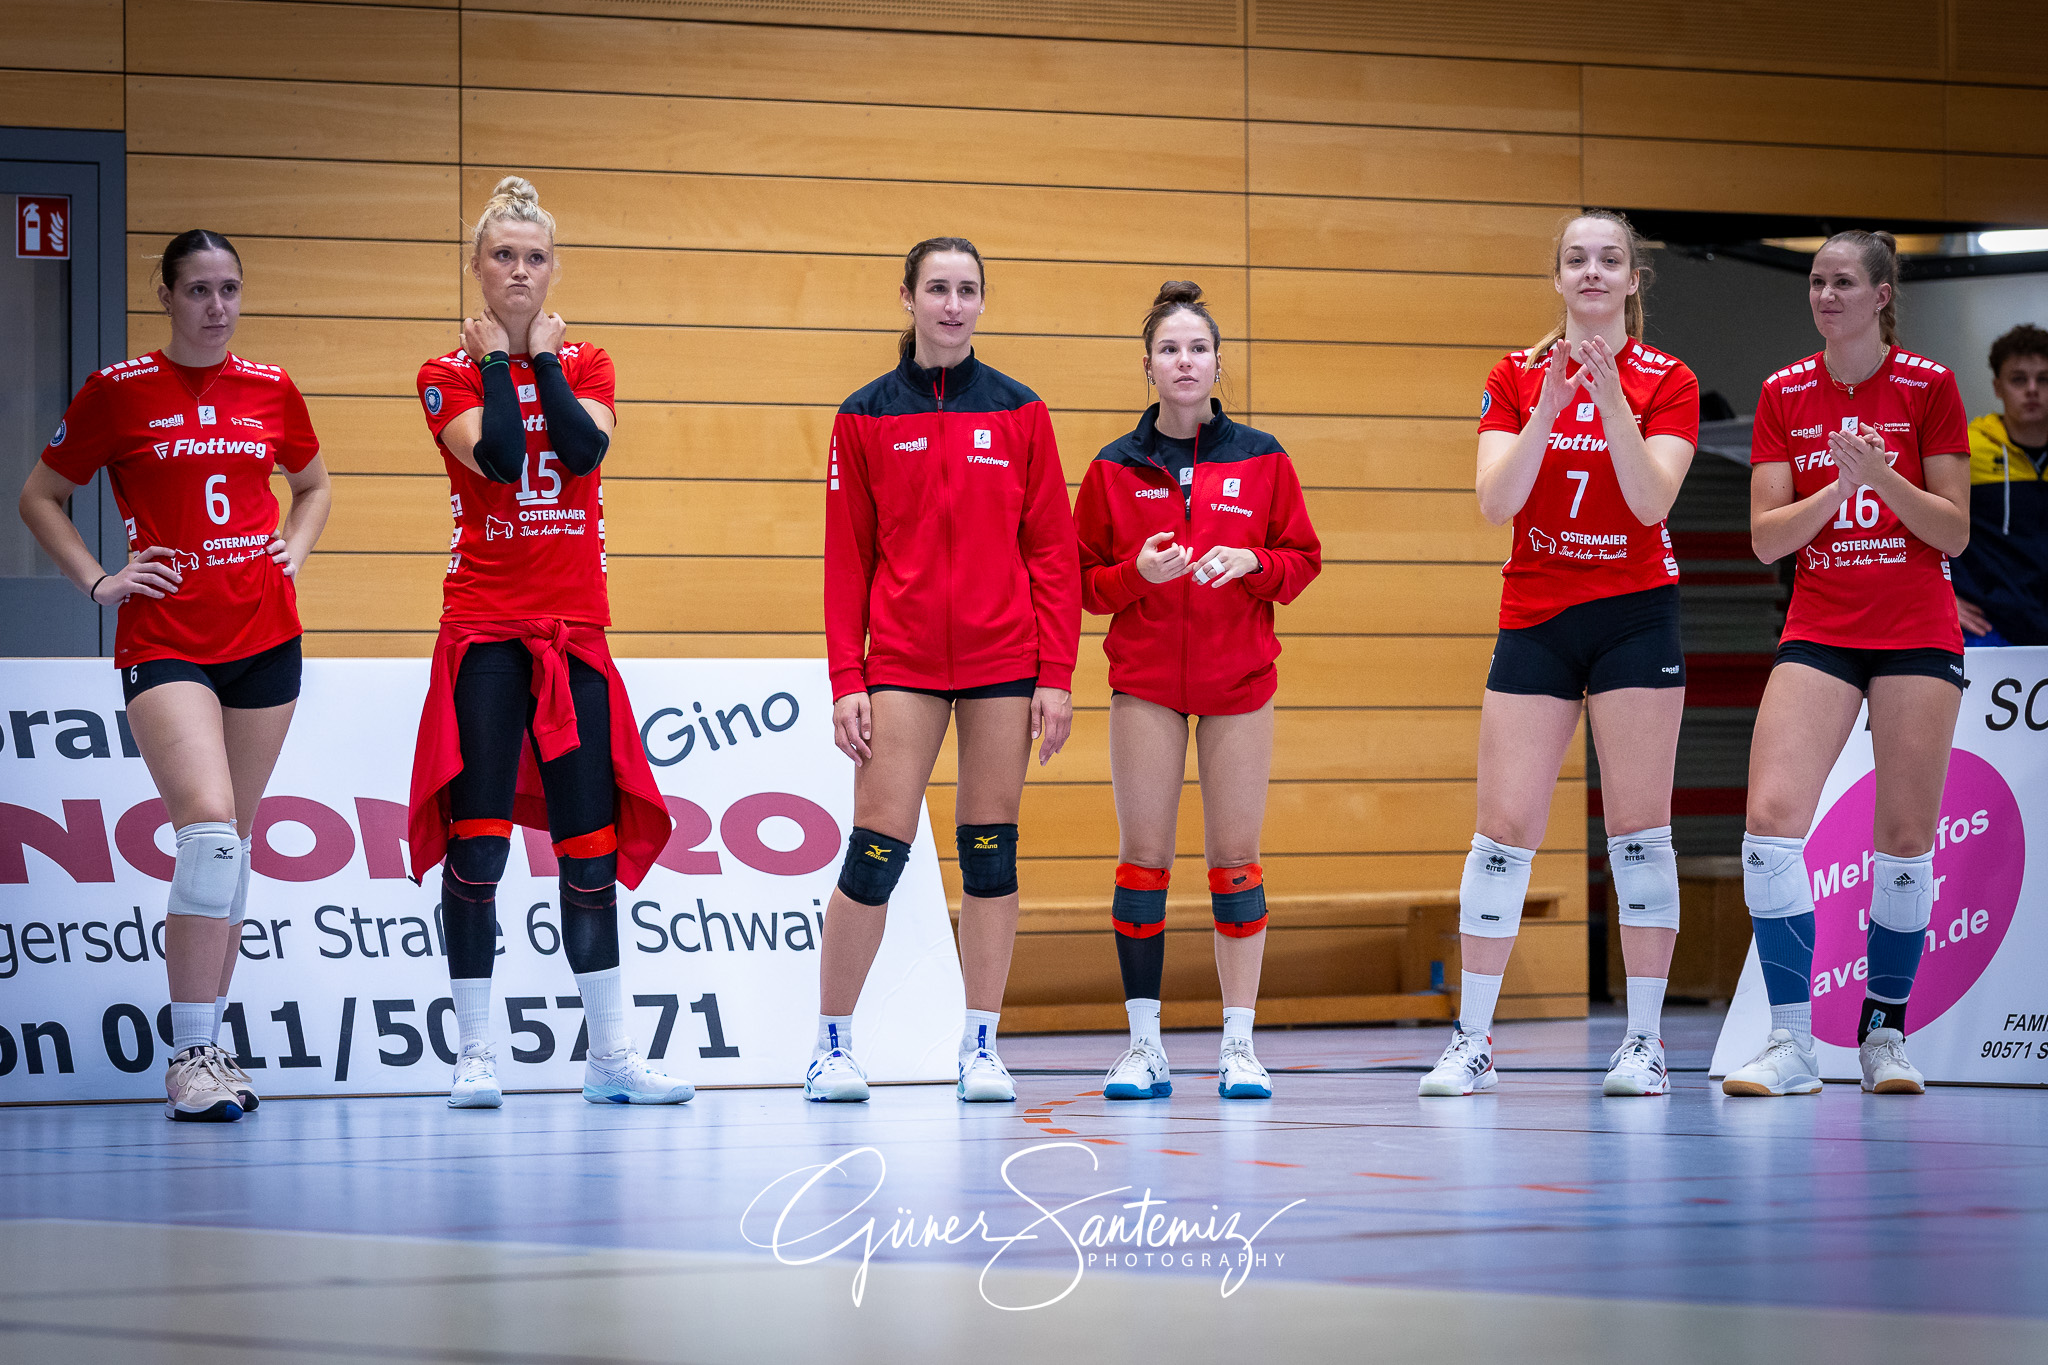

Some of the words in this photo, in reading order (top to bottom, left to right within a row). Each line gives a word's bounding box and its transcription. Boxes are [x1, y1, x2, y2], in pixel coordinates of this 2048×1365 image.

[121, 365, 159, 380] Flottweg
[242, 368, 281, 381] Flottweg
[1781, 379, 1817, 394] Flottweg
[148, 414, 184, 428] capelli
[1790, 424, 1823, 438] capelli
[172, 438, 267, 459] Flottweg
[893, 437, 928, 451] capelli
[1547, 432, 1611, 452] Flottw
[973, 455, 1009, 468] Flottweg
[516, 451, 562, 499] 15
[205, 474, 230, 526] 6
[1135, 488, 1169, 499] capelli
[1566, 470, 1589, 519] 7
[1217, 503, 1254, 518] Flottweg
[1833, 484, 1880, 530] 16
[1560, 531, 1628, 545] OSTERMAIER
[1831, 537, 1906, 553] OSTERMAIER
[130, 664, 138, 684] 6
[641, 691, 800, 768] Gino
[631, 898, 824, 954] Schwai
[632, 993, 741, 1060] 71
[1980, 1040, 2033, 1059] 90571
